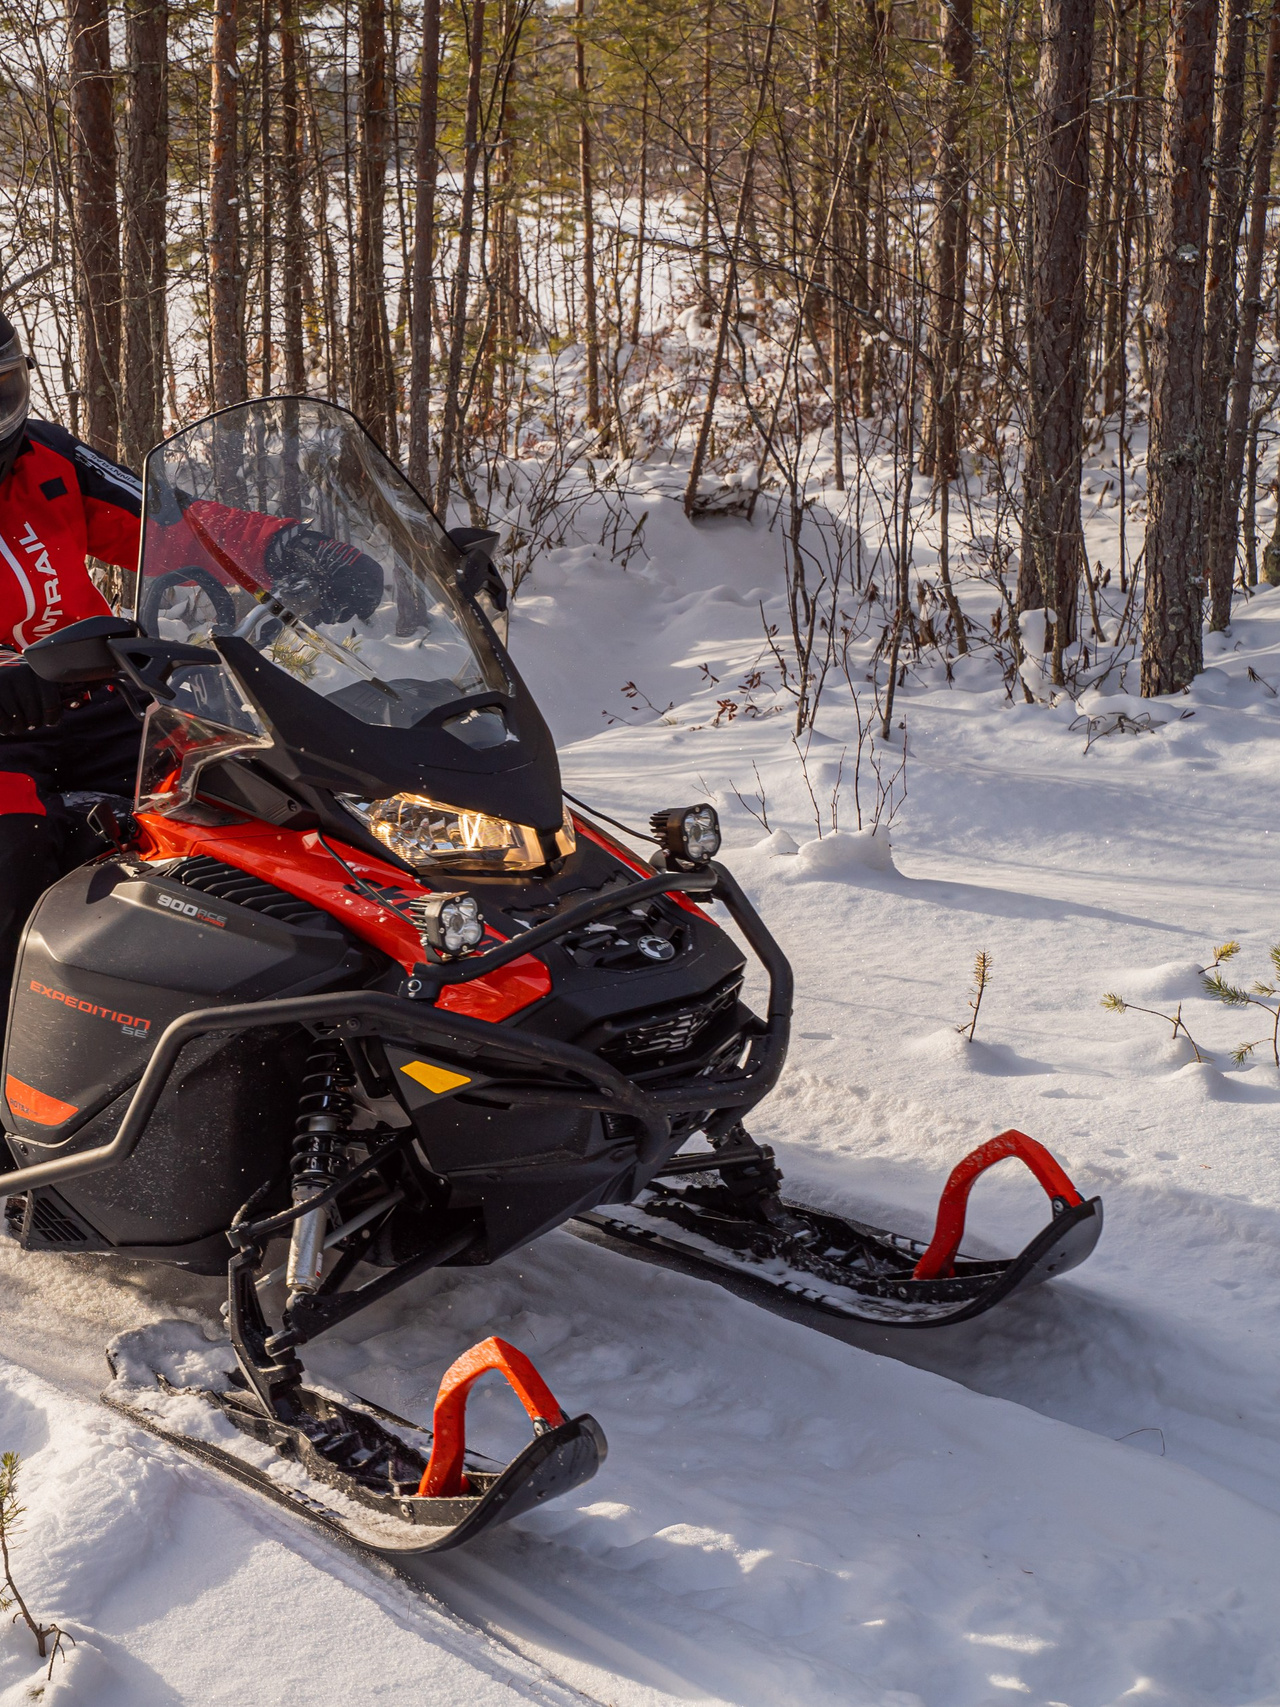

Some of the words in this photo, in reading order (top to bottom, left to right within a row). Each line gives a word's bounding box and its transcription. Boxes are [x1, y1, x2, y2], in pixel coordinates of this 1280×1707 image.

[89, 453, 136, 483] FINNTRAIL
[157, 894, 198, 917] 900
[198, 908, 227, 924] ACE
[29, 980, 151, 1030] EXPEDITION
[121, 1025, 148, 1039] SE
